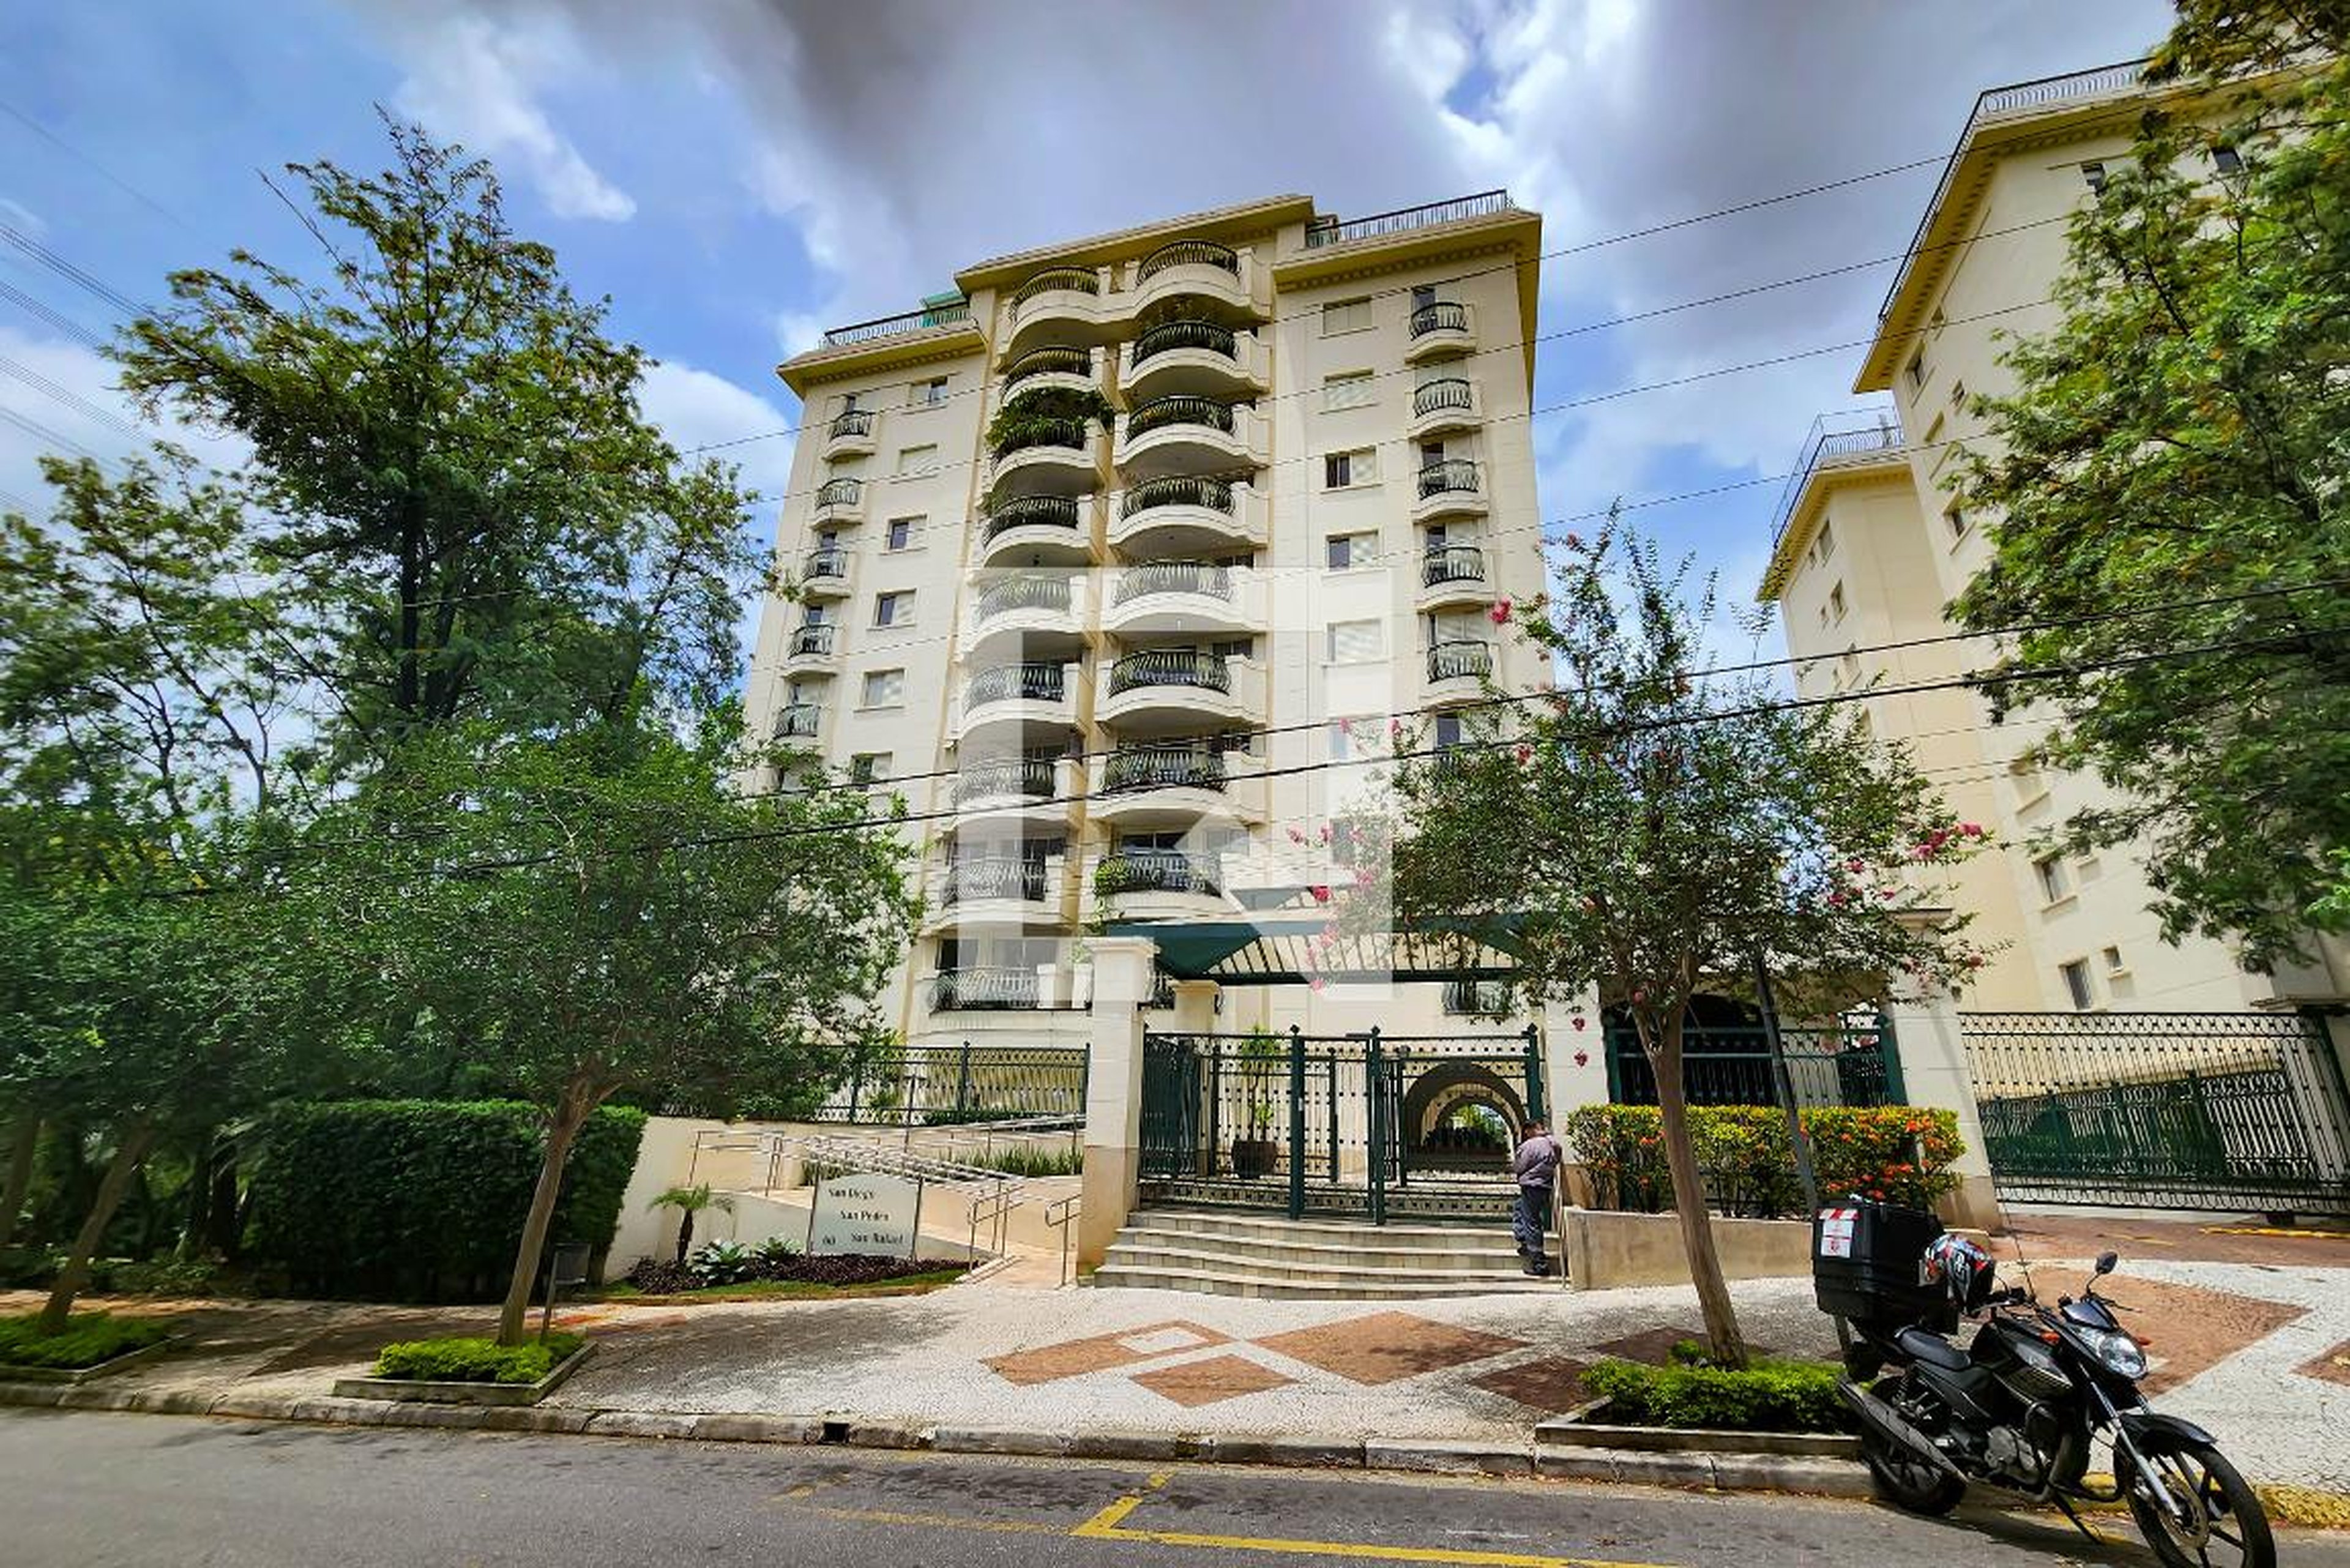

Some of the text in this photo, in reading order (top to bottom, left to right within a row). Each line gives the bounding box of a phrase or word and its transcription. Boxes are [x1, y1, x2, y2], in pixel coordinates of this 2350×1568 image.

[828, 1188, 846, 1197] San
[840, 1210, 889, 1221] San Pedro
